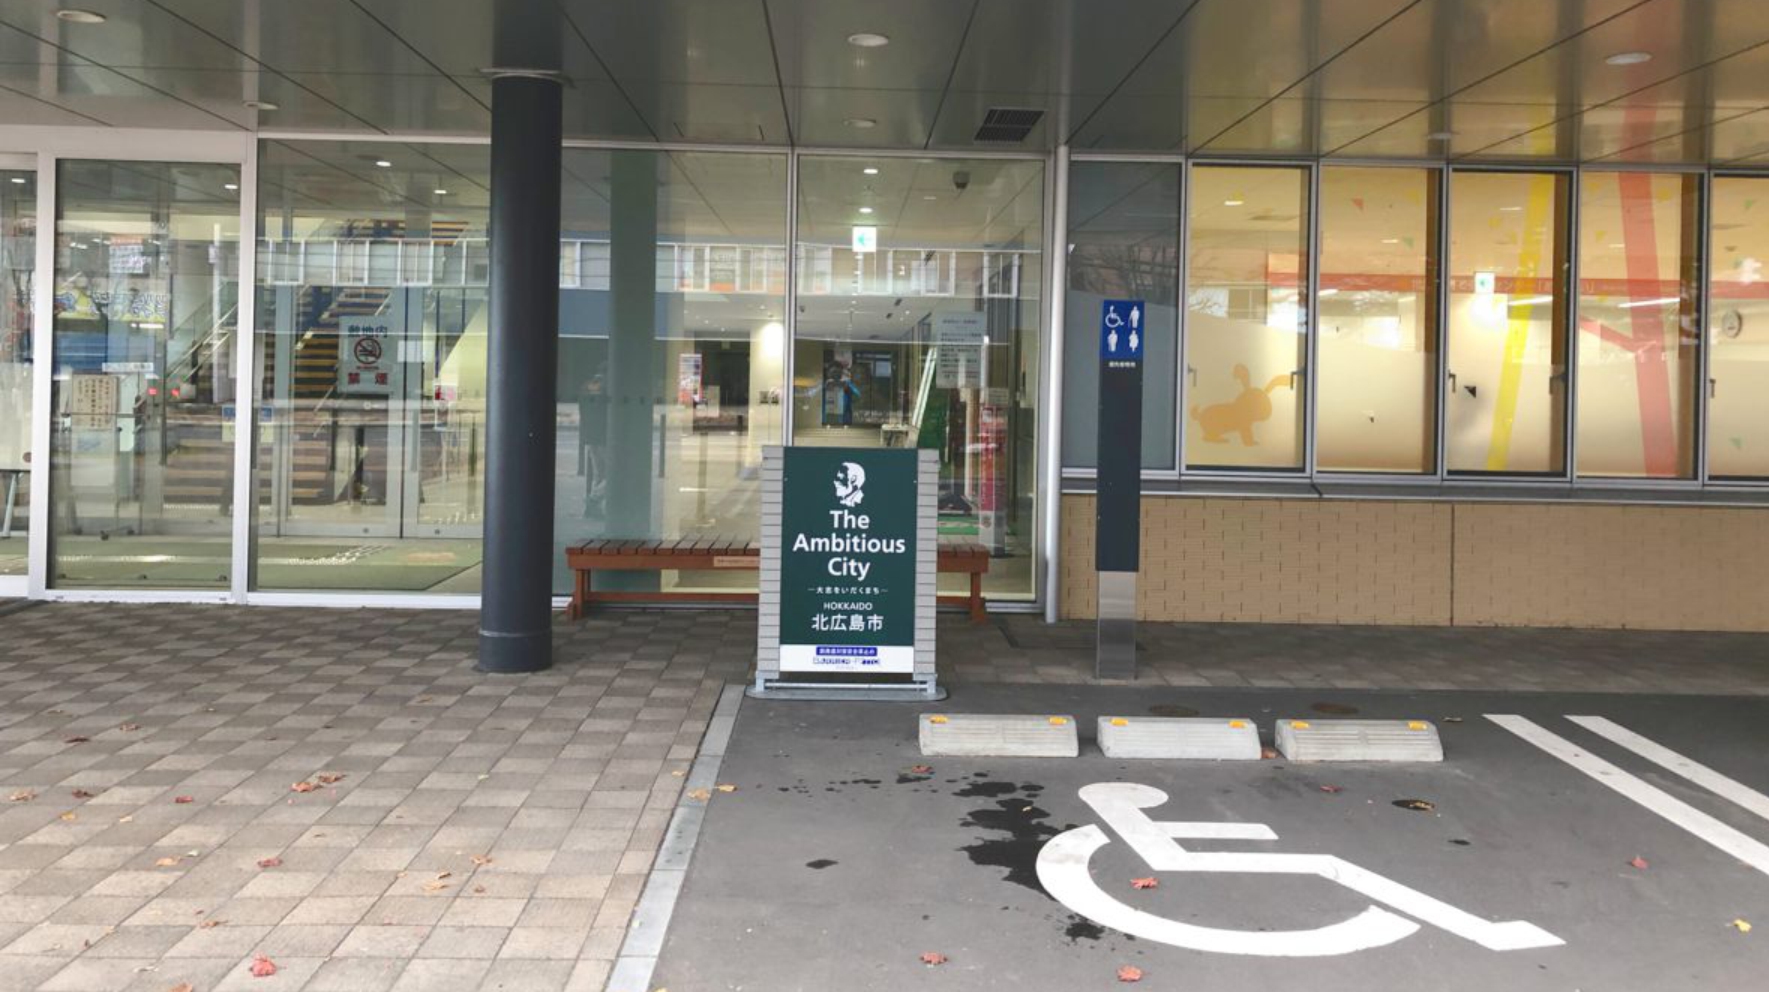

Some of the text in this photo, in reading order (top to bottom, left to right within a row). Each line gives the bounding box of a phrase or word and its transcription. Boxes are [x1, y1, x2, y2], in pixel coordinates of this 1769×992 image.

[829, 509, 870, 529] The
[792, 532, 906, 553] Ambitious
[827, 556, 871, 581] City
[823, 601, 873, 611] HOKKAIDO
[811, 613, 884, 632] 北広島市
